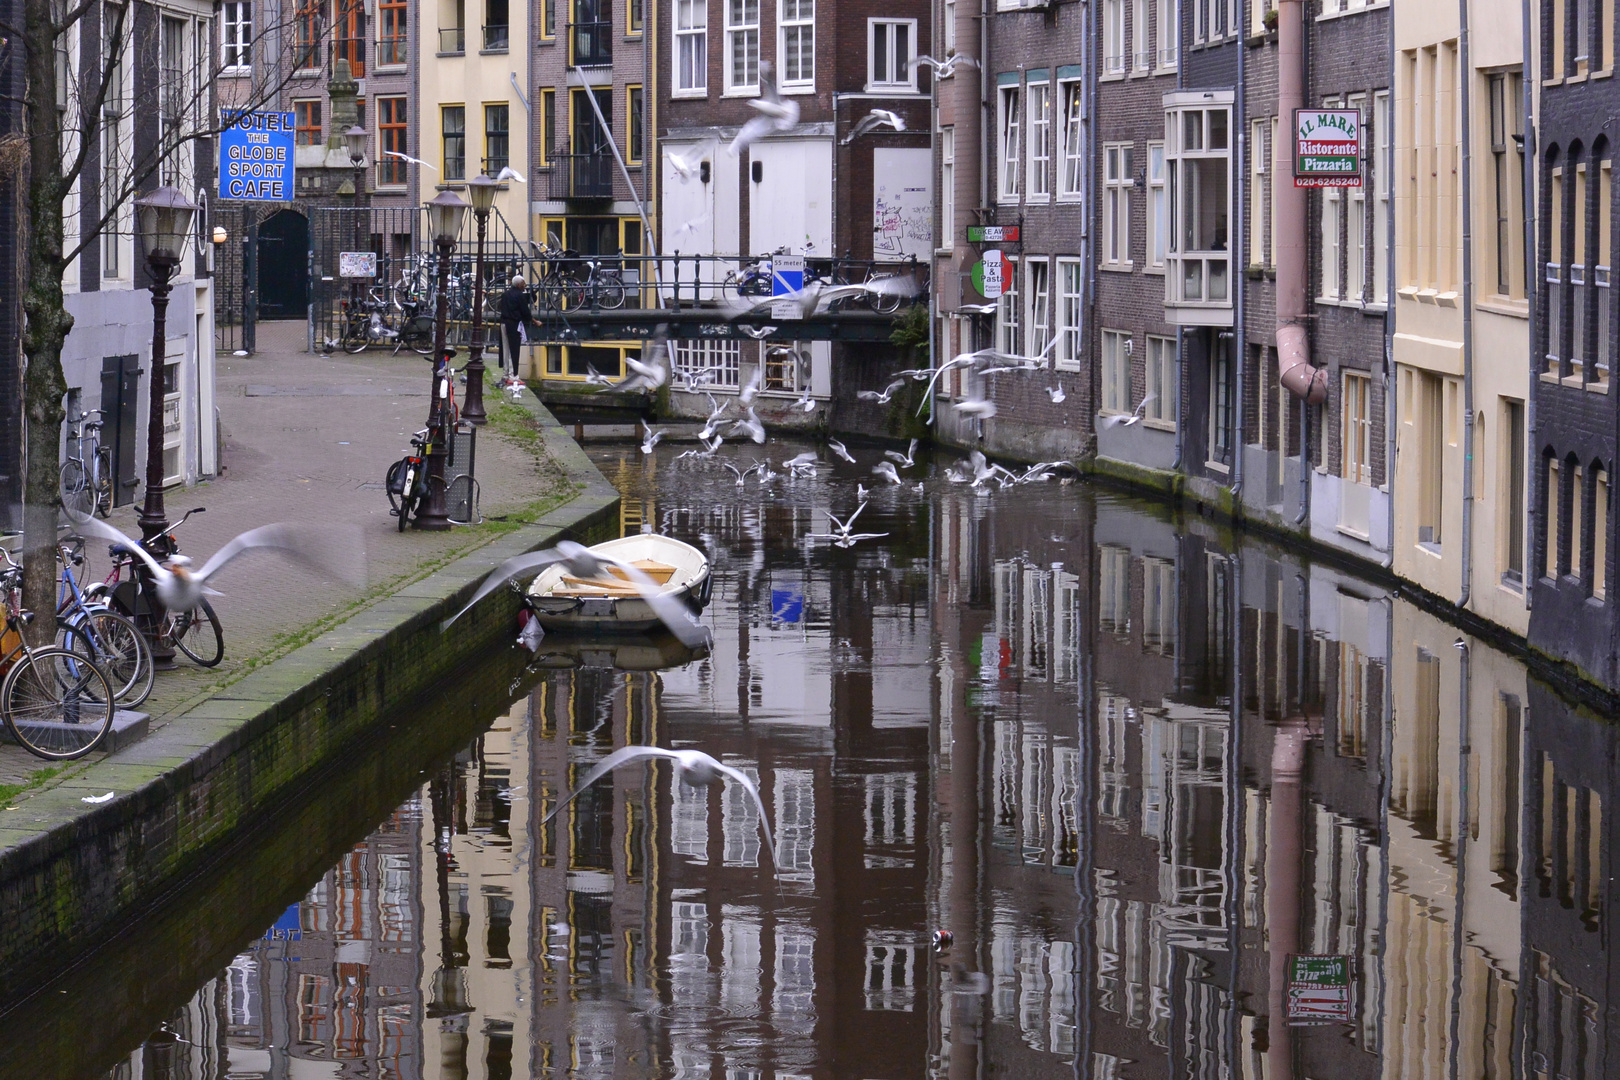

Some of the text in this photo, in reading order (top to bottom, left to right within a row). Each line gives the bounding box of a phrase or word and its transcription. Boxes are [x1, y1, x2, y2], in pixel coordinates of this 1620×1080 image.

[1300, 114, 1357, 139] IL MARE
[246, 132, 269, 143] THE
[228, 144, 286, 161] GLOBE
[1299, 141, 1357, 155] Ristorante
[228, 161, 285, 178] SPORT
[1304, 158, 1352, 171] Pizzaria
[229, 179, 283, 198] CAFE
[1296, 178, 1359, 186] 020-6245240
[981, 260, 1004, 268] Pizza
[988, 268, 996, 276] &
[980, 275, 1005, 283] Pasta
